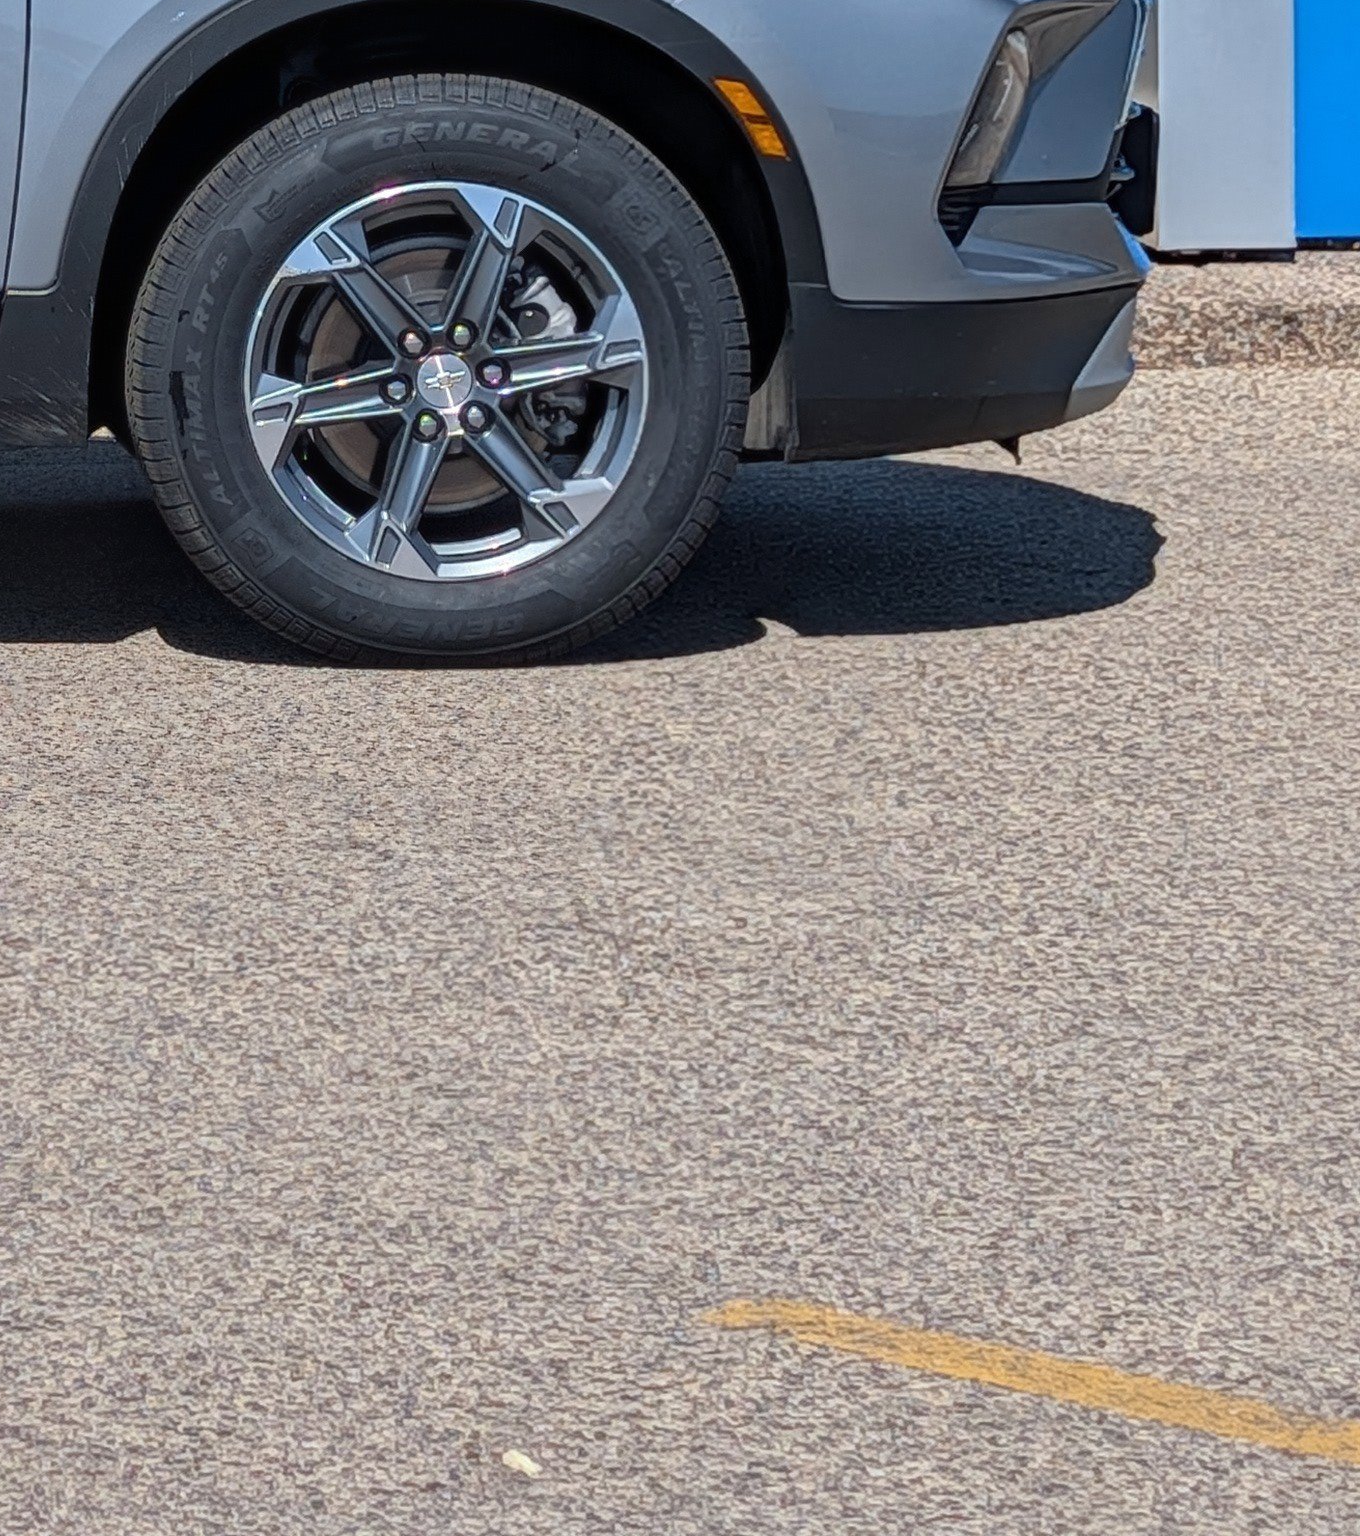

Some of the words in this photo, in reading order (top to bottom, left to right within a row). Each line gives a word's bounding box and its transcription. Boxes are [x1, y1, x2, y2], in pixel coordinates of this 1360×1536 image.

[371, 120, 589, 179] GENERAL
[191, 282, 215, 334] RT
[185, 347, 234, 506] ALTIMAX
